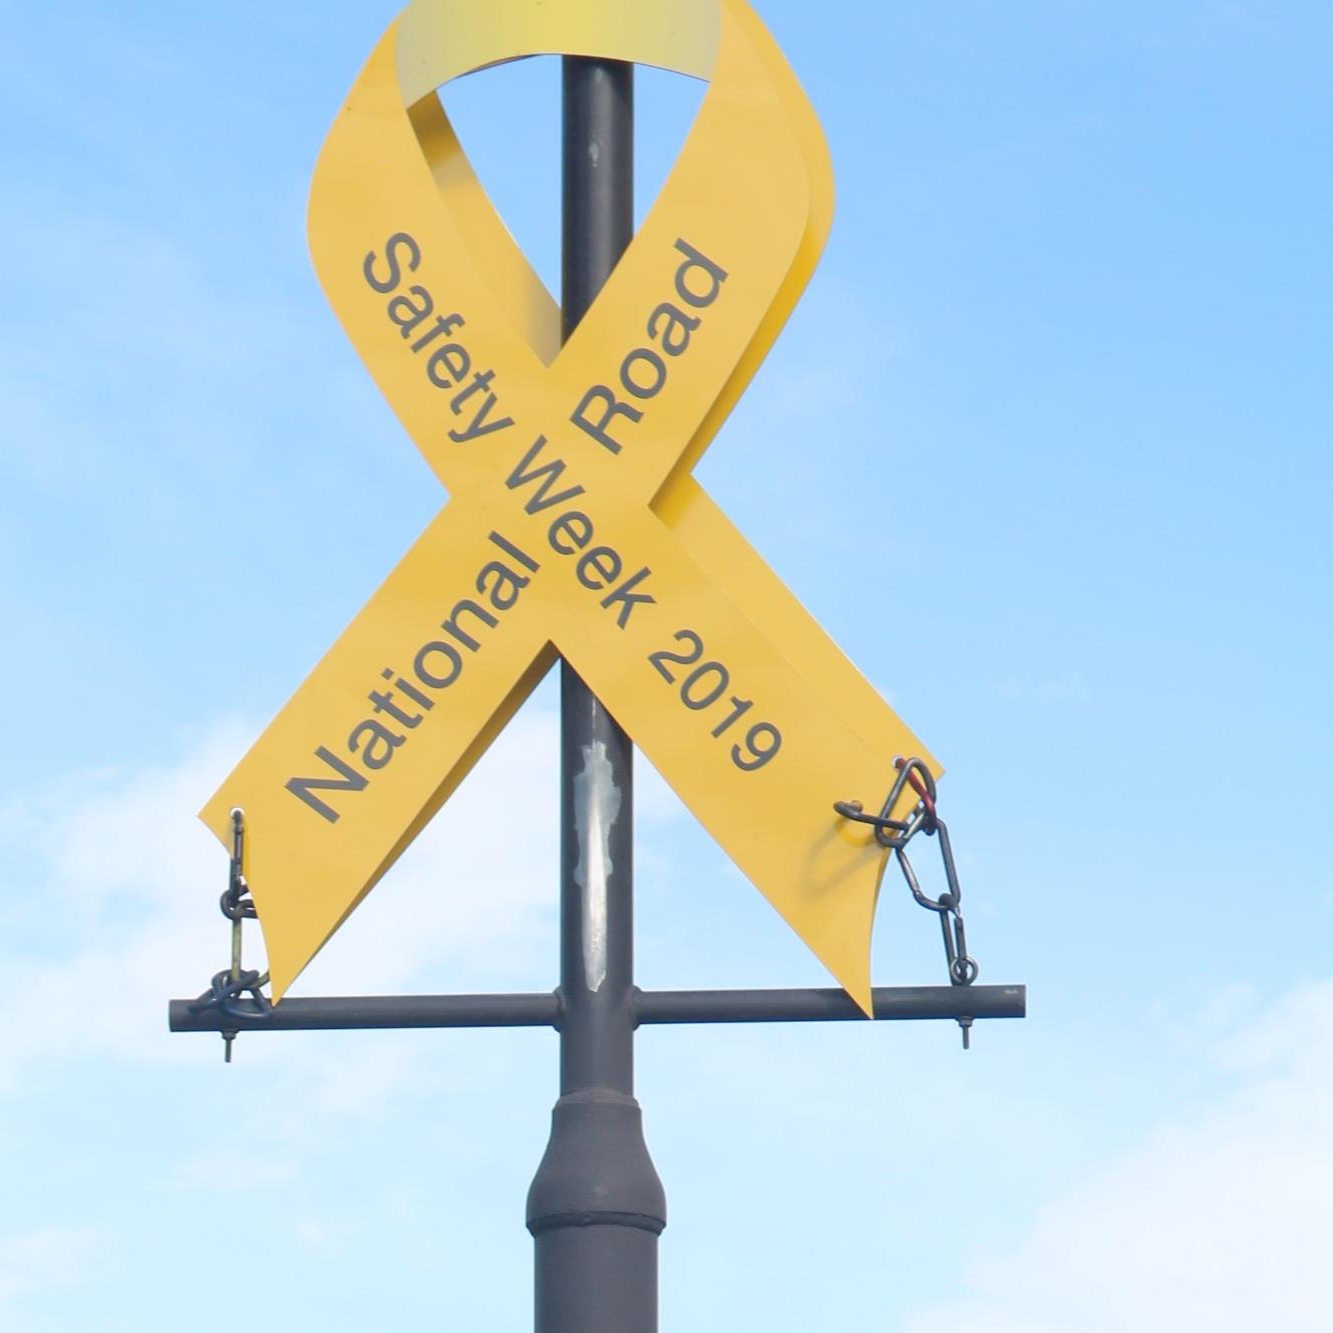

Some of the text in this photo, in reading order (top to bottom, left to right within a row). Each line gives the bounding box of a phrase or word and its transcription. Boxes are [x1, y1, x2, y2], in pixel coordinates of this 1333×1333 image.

[285, 239, 728, 823] National Road
[363, 232, 783, 772] Safety Week 2019
